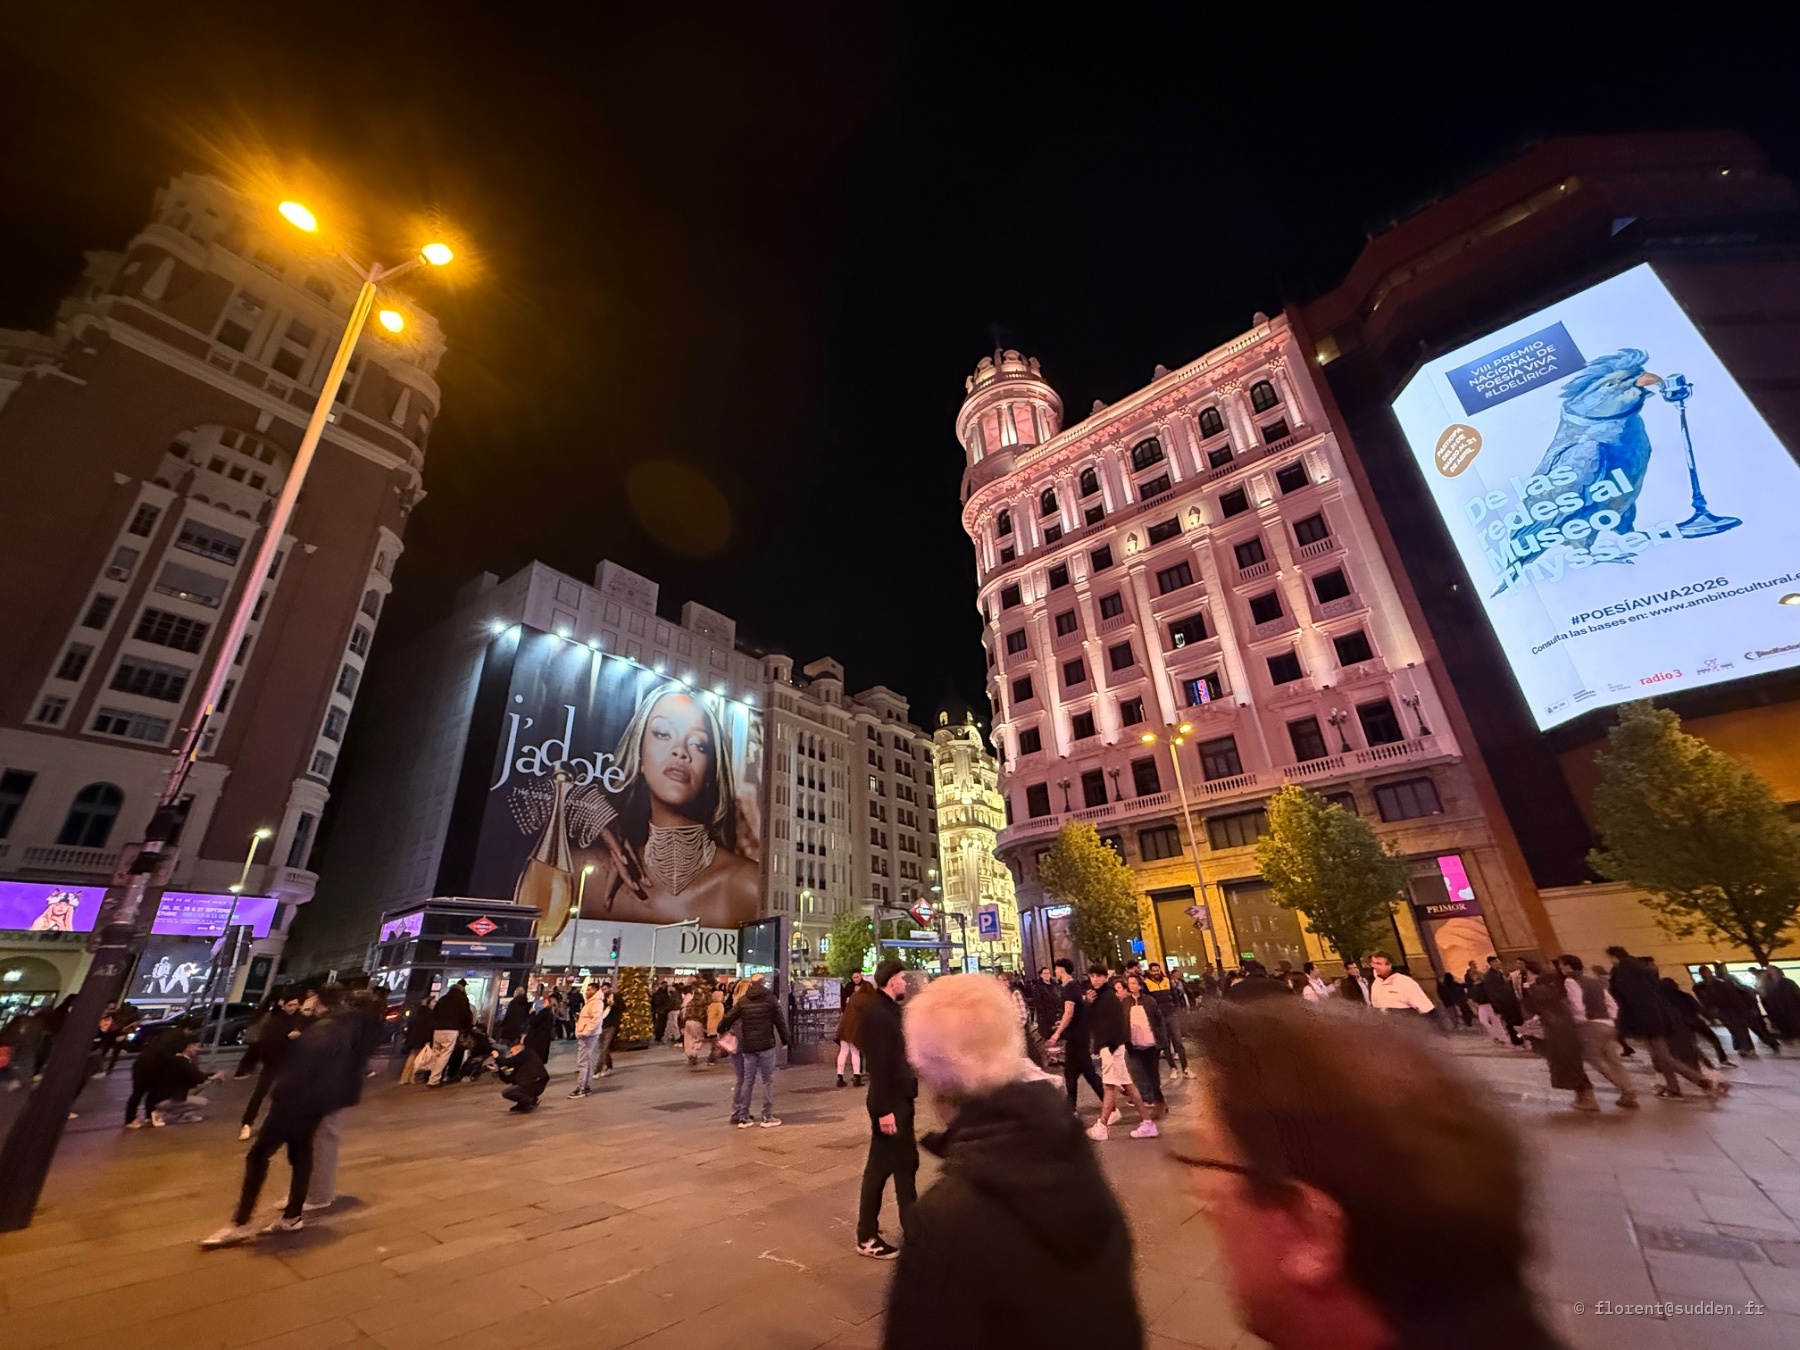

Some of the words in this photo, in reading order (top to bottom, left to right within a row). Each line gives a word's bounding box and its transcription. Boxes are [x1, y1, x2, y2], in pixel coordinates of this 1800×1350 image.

[1468, 354, 1535, 387] NACIONAL
[1536, 344, 1556, 357] DE
[1471, 363, 1492, 376] VIII
[1493, 340, 1544, 367] PREMIO
[1476, 367, 1524, 392] POESÍA
[1523, 354, 1557, 371] VIVA
[1485, 364, 1558, 398] #LDELÍRICA
[1464, 489, 1509, 527] De
[1510, 465, 1577, 500] las
[1477, 491, 1584, 549] redes
[1589, 467, 1634, 502] al
[1486, 509, 1621, 576] Museo
[1497, 520, 1683, 596] Thyssen
[1571, 576, 1729, 625] #POESÍAVIVA2026
[1531, 631, 1568, 655] Consulta
[1568, 626, 1587, 639] las
[1589, 618, 1627, 633] bases
[1628, 611, 1649, 623] en:
[1639, 671, 1673, 685] radio
[1673, 669, 1683, 678] 3
[980, 914, 993, 932] P
[1426, 903, 1467, 914] PRIMOR
[680, 930, 736, 955] DIOR
[555, 977, 580, 985] FIE
